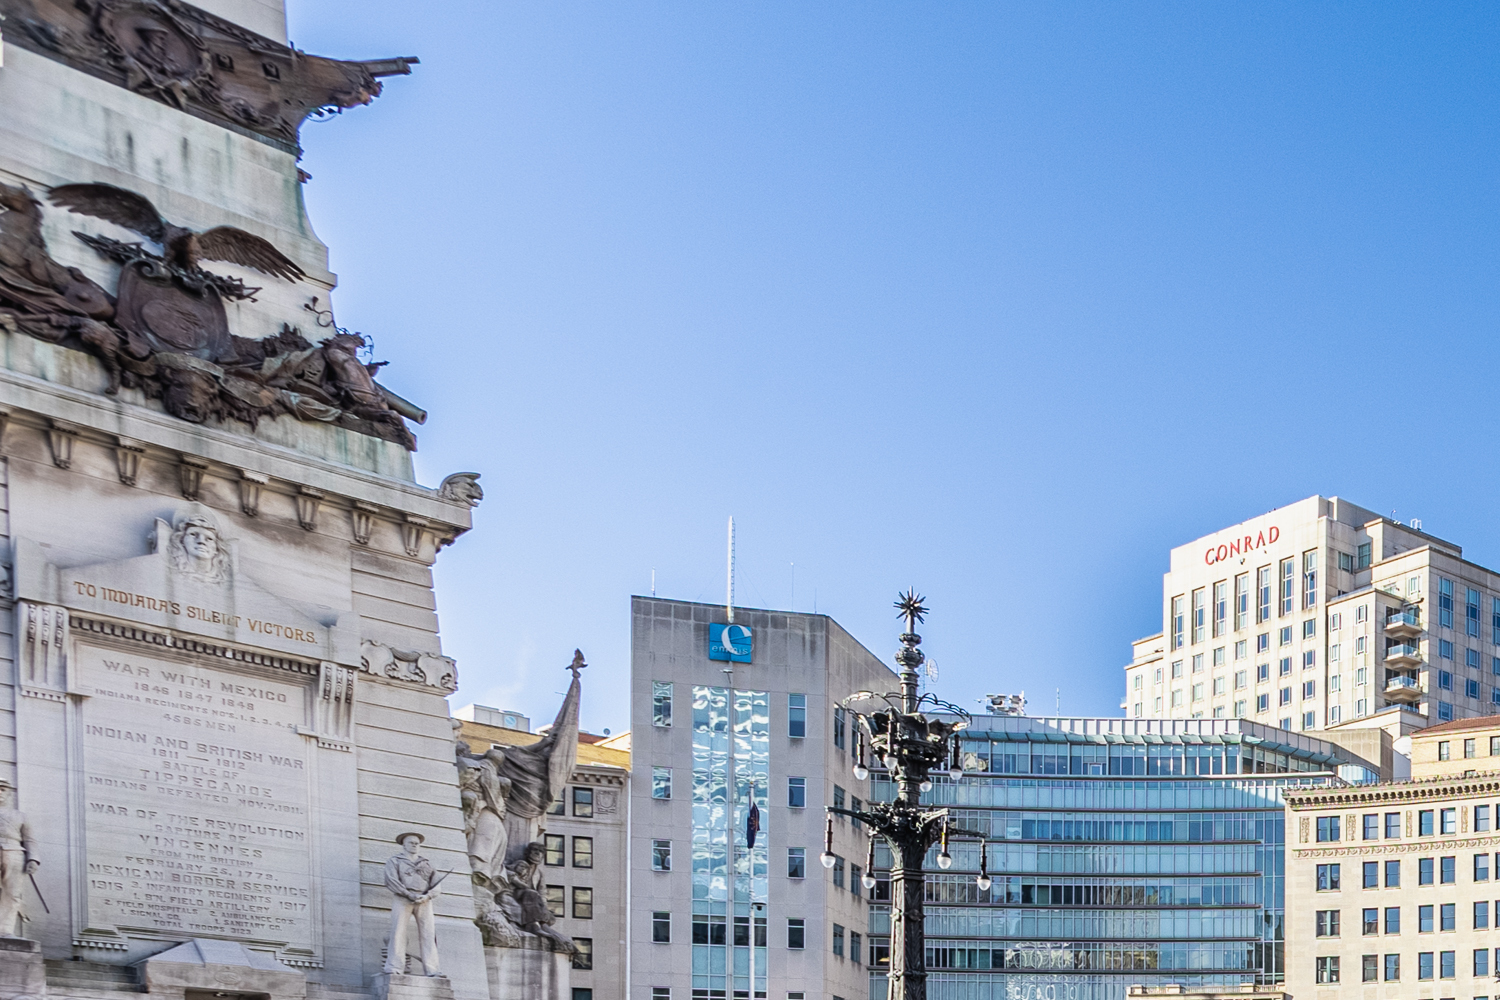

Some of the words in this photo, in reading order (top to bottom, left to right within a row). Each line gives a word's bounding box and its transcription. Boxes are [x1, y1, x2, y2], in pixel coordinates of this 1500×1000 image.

[1205, 526, 1280, 566] CONRAD
[73, 581, 97, 598] TO
[100, 586, 181, 615] INDIANA'S
[186, 605, 242, 628] SILENT
[247, 618, 318, 644] VICTORS.
[103, 660, 149, 677] WAR
[161, 671, 211, 689] WITH
[221, 682, 287, 703] MEXICO
[95, 688, 141, 702] INDIANA
[145, 697, 208, 714] REGIMENTS
[179, 690, 213, 703] 1847
[206, 720, 236, 733] MEN
[86, 724, 147, 743] INDIAN
[154, 736, 188, 750] AND
[197, 743, 263, 762] BRITISH
[269, 754, 304, 770] WAR
[163, 760, 217, 776] BATTLE
[223, 770, 240, 779] OF
[217, 759, 246, 770] 1812
[89, 776, 147, 791] INDIANS
[157, 786, 229, 803] DEFEATED
[139, 768, 273, 798] TIPPECANOE
[89, 802, 128, 816] WAR
[136, 809, 158, 819] OF
[166, 813, 199, 826] THE
[205, 818, 304, 840] REVOLUTION
[155, 824, 220, 840] CAPTURE
[229, 834, 247, 842] OF
[139, 834, 263, 858] VINCENNES
[125, 855, 203, 872] FEBRUARY
[150, 848, 182, 858] FROM
[186, 852, 206, 861] THE
[210, 856, 254, 867] BRITISH
[89, 863, 164, 880] MEXICAN
[171, 872, 235, 890] BORDER
[242, 881, 308, 897] SERVICE
[146, 883, 203, 895] INFANTRY
[208, 889, 271, 903] REGIMENTS
[117, 900, 144, 909] FIELD
[147, 904, 198, 914] HOSPITALS
[221, 911, 272, 923] AMBULANCE
[130, 910, 163, 918] SIGNAL
[170, 896, 203, 907] FIELD
[209, 901, 270, 913] ARTILLERY
[279, 901, 306, 911] 1917
[154, 919, 184, 929] TOTAL
[188, 923, 226, 933] TROOPS
[223, 919, 266, 929] SANITARY
